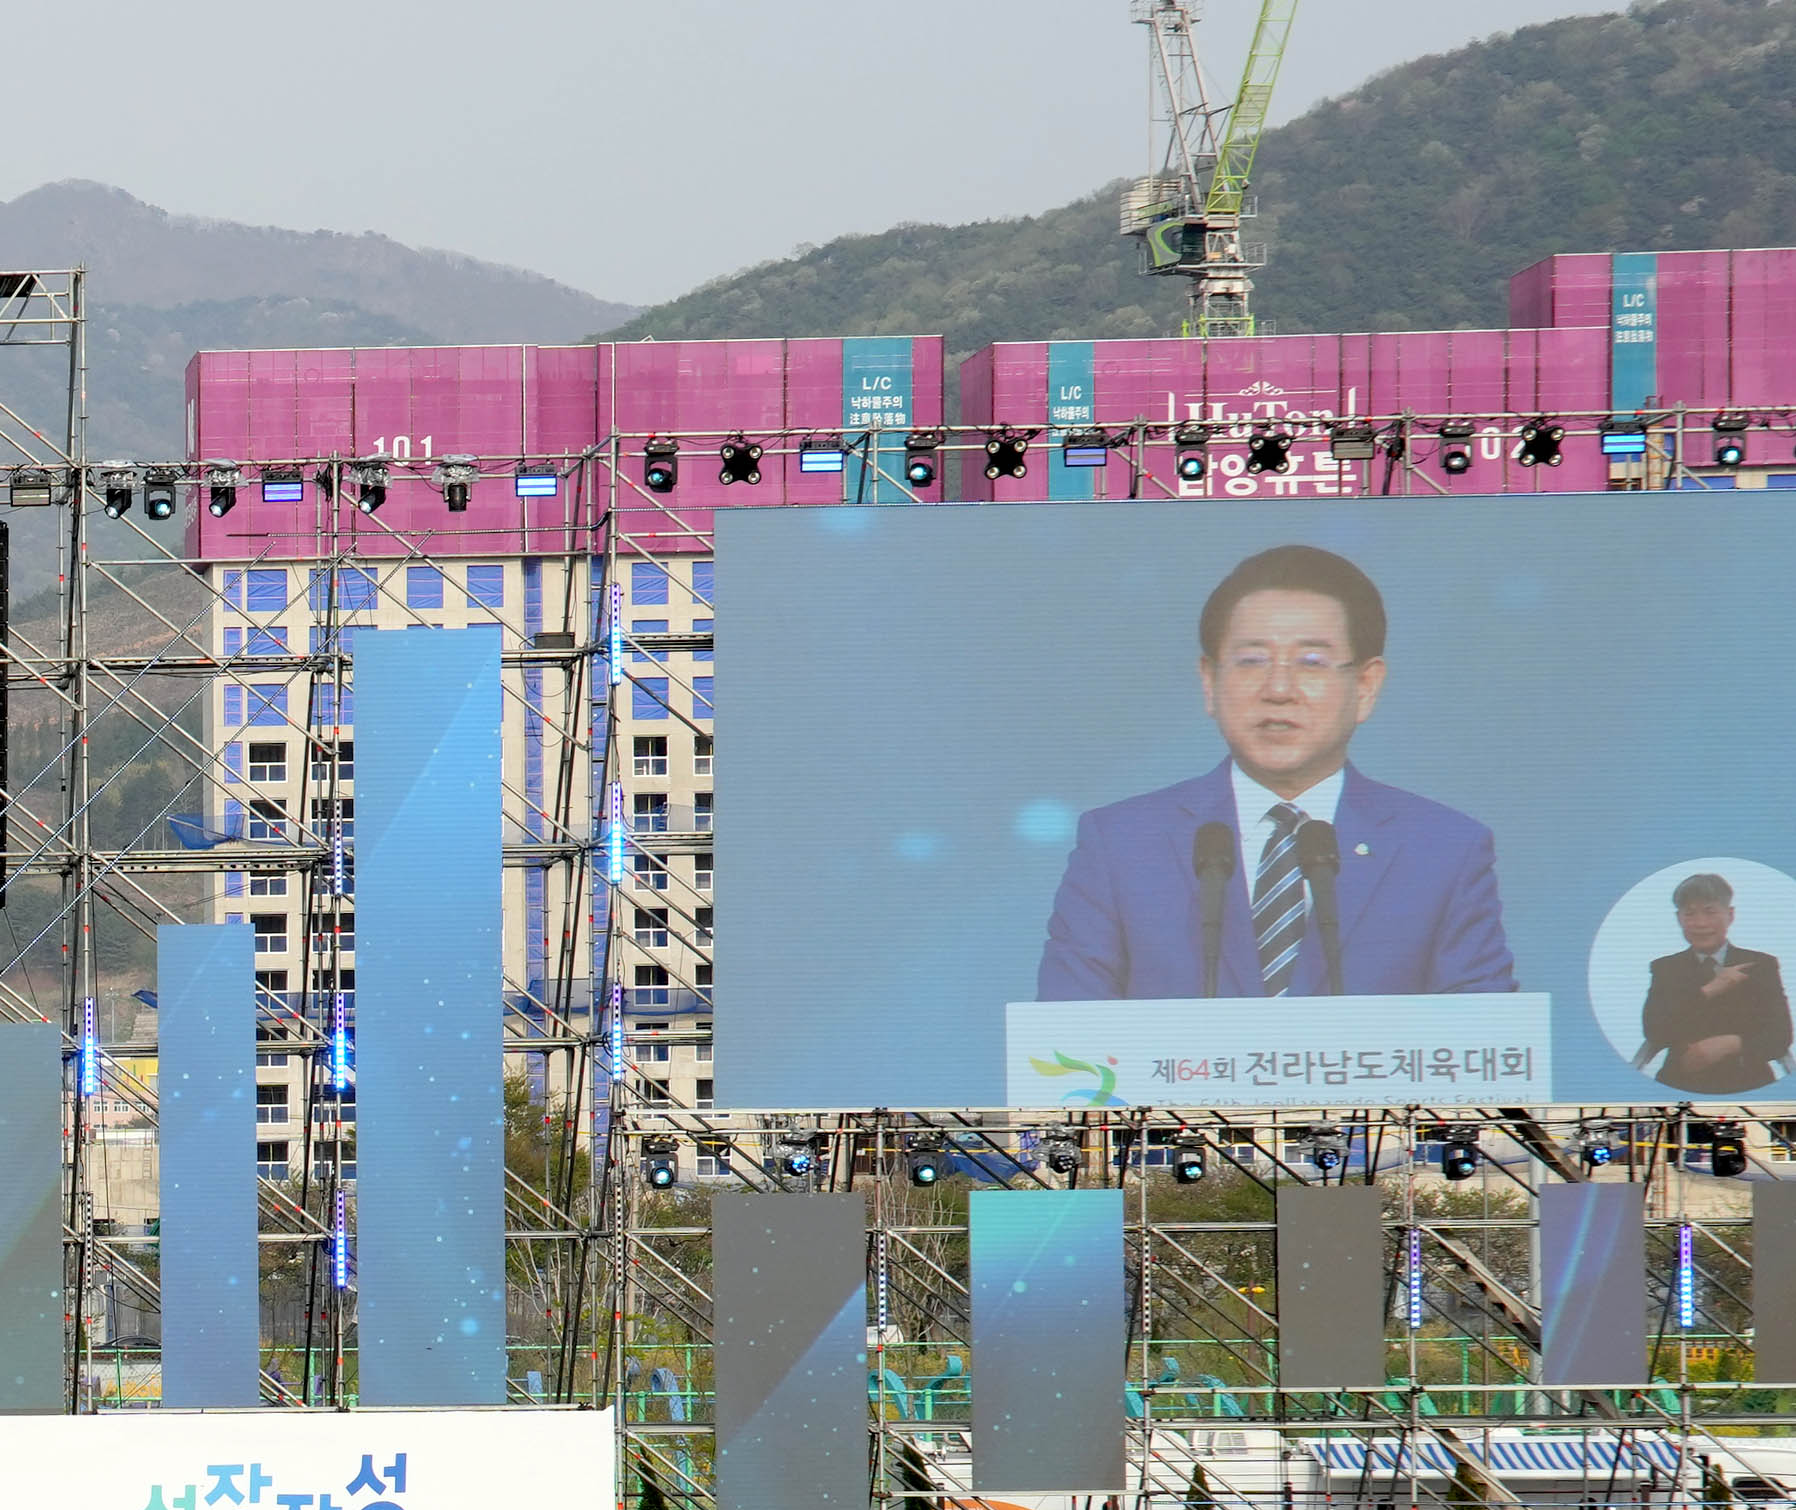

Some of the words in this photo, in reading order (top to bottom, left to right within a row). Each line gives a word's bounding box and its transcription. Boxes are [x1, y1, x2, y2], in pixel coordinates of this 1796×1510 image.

[862, 377, 892, 391] L/C
[1060, 386, 1082, 400] L/C
[851, 396, 903, 410] 낙하물주의
[1151, 1056, 1236, 1084] 제64회
[1244, 1047, 1533, 1086] 전라남도체육대회
